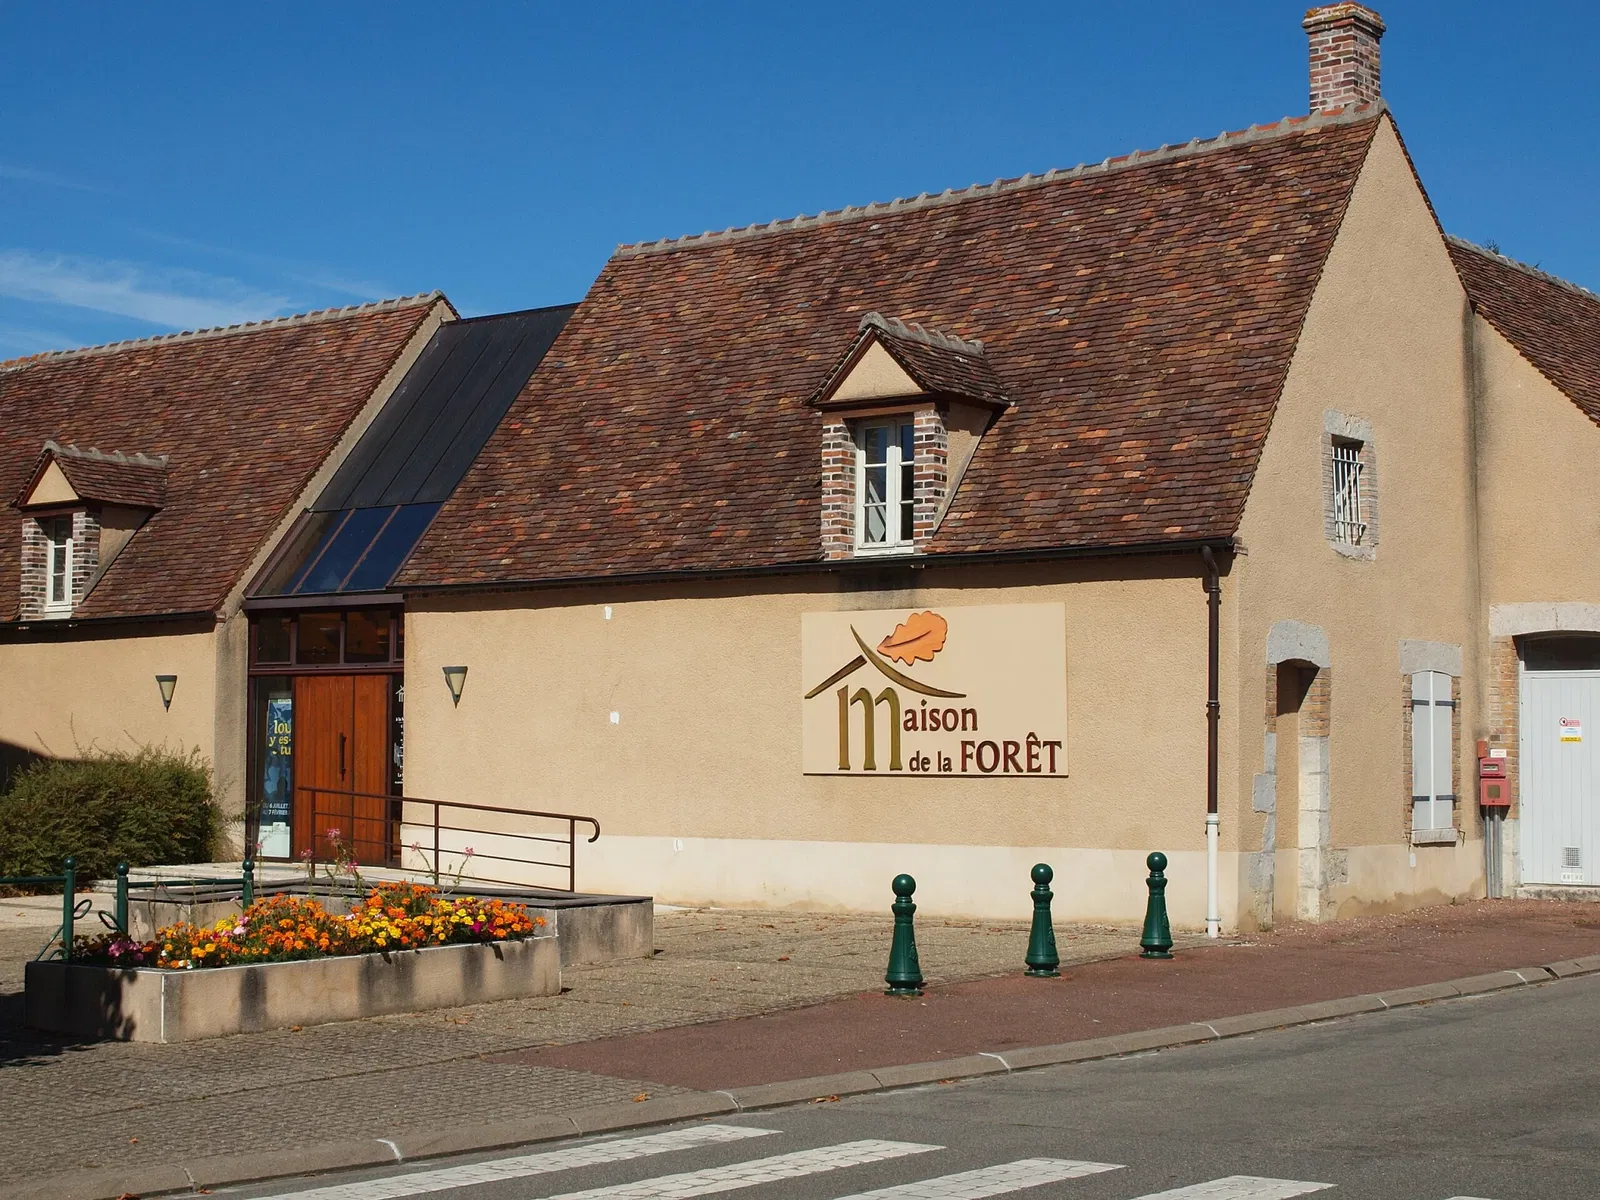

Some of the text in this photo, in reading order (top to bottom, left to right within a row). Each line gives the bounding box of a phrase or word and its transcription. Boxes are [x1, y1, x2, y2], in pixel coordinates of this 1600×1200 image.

[268, 736, 277, 747] y
[909, 732, 1063, 773] de la FORÊT
